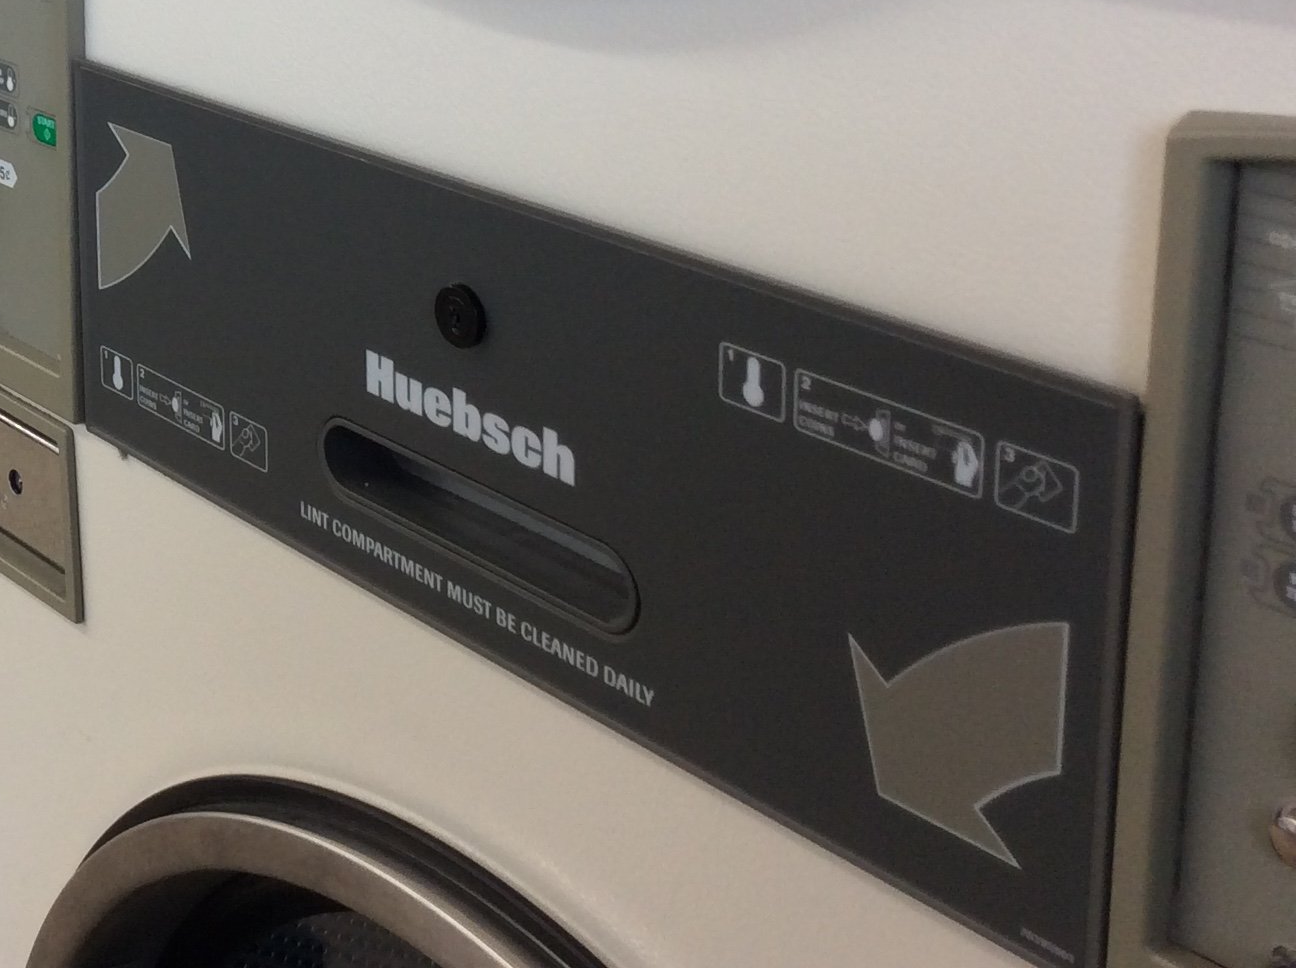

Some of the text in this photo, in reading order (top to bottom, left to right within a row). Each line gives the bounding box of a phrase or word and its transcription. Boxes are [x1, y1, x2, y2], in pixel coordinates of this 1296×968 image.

[366, 349, 575, 487] Huebsch
[300, 501, 654, 707] LINT COMPARTMENT MUST BE CLEANED DAILY
